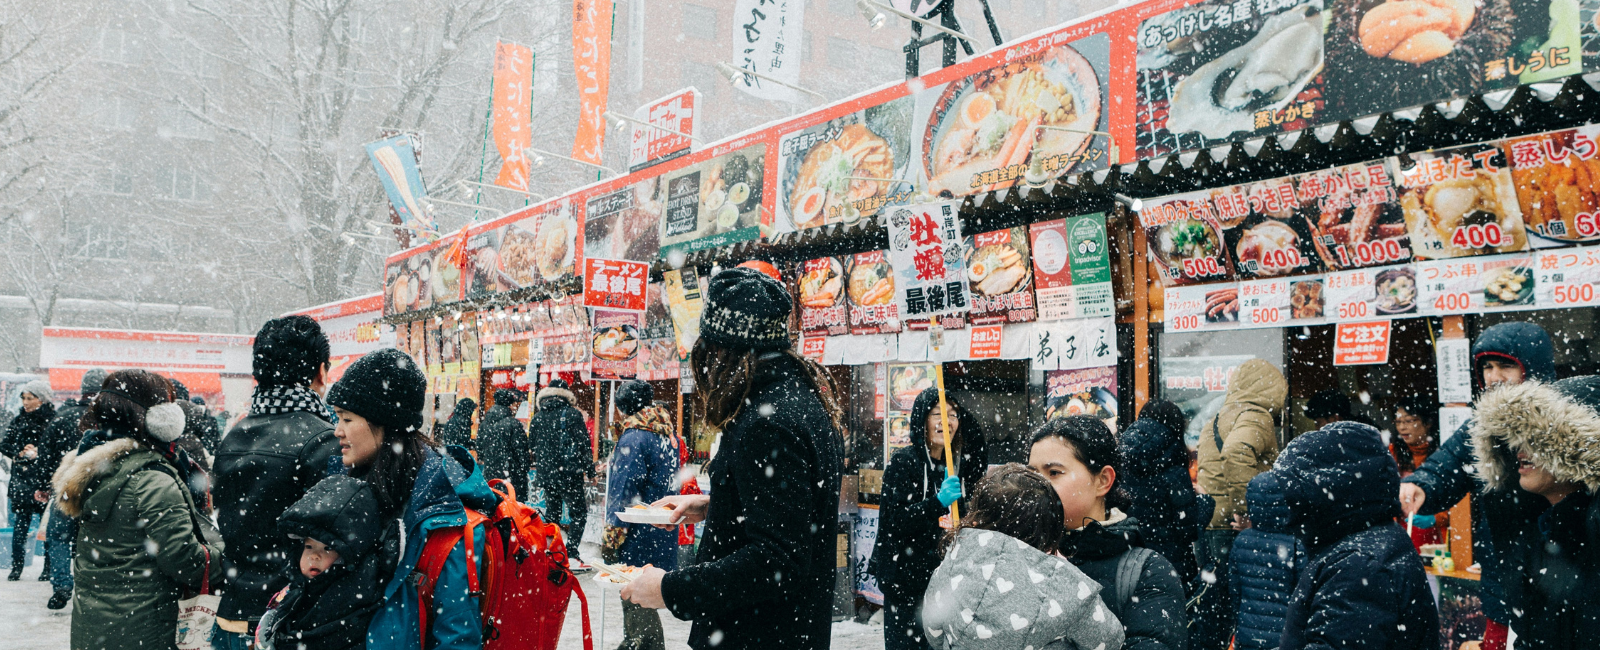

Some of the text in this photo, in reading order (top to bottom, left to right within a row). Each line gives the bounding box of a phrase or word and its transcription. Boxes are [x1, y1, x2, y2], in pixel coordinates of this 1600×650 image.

[1484, 47, 1570, 81] 蒸しうに
[782, 127, 844, 156] 弟子屈ラーメン
[970, 148, 1102, 188] 北海道全部の味噌ラーメン
[1301, 165, 1391, 199] 焼かに足
[1216, 183, 1300, 219] 焼ほっき貝
[1141, 197, 1213, 228] 牡蠣のみそ汁
[1575, 212, 1600, 235] 6
[909, 211, 947, 281] 牡蠣
[977, 232, 1008, 246] ラーメン
[592, 260, 643, 277] ラーメン
[805, 260, 829, 271] ラーメン
[856, 253, 882, 265] ラーメン
[1074, 255, 1102, 264] tripadvisor
[1424, 263, 1478, 280] つぶ串
[590, 273, 642, 296] 最後尾
[1243, 282, 1287, 296] 焼おにぎり
[905, 281, 966, 315] 最後尾
[851, 304, 899, 324] かに味噌
[972, 330, 1000, 342] お渡し口
[1340, 325, 1387, 344] ご注文
[184, 605, 218, 617] MICKEY
